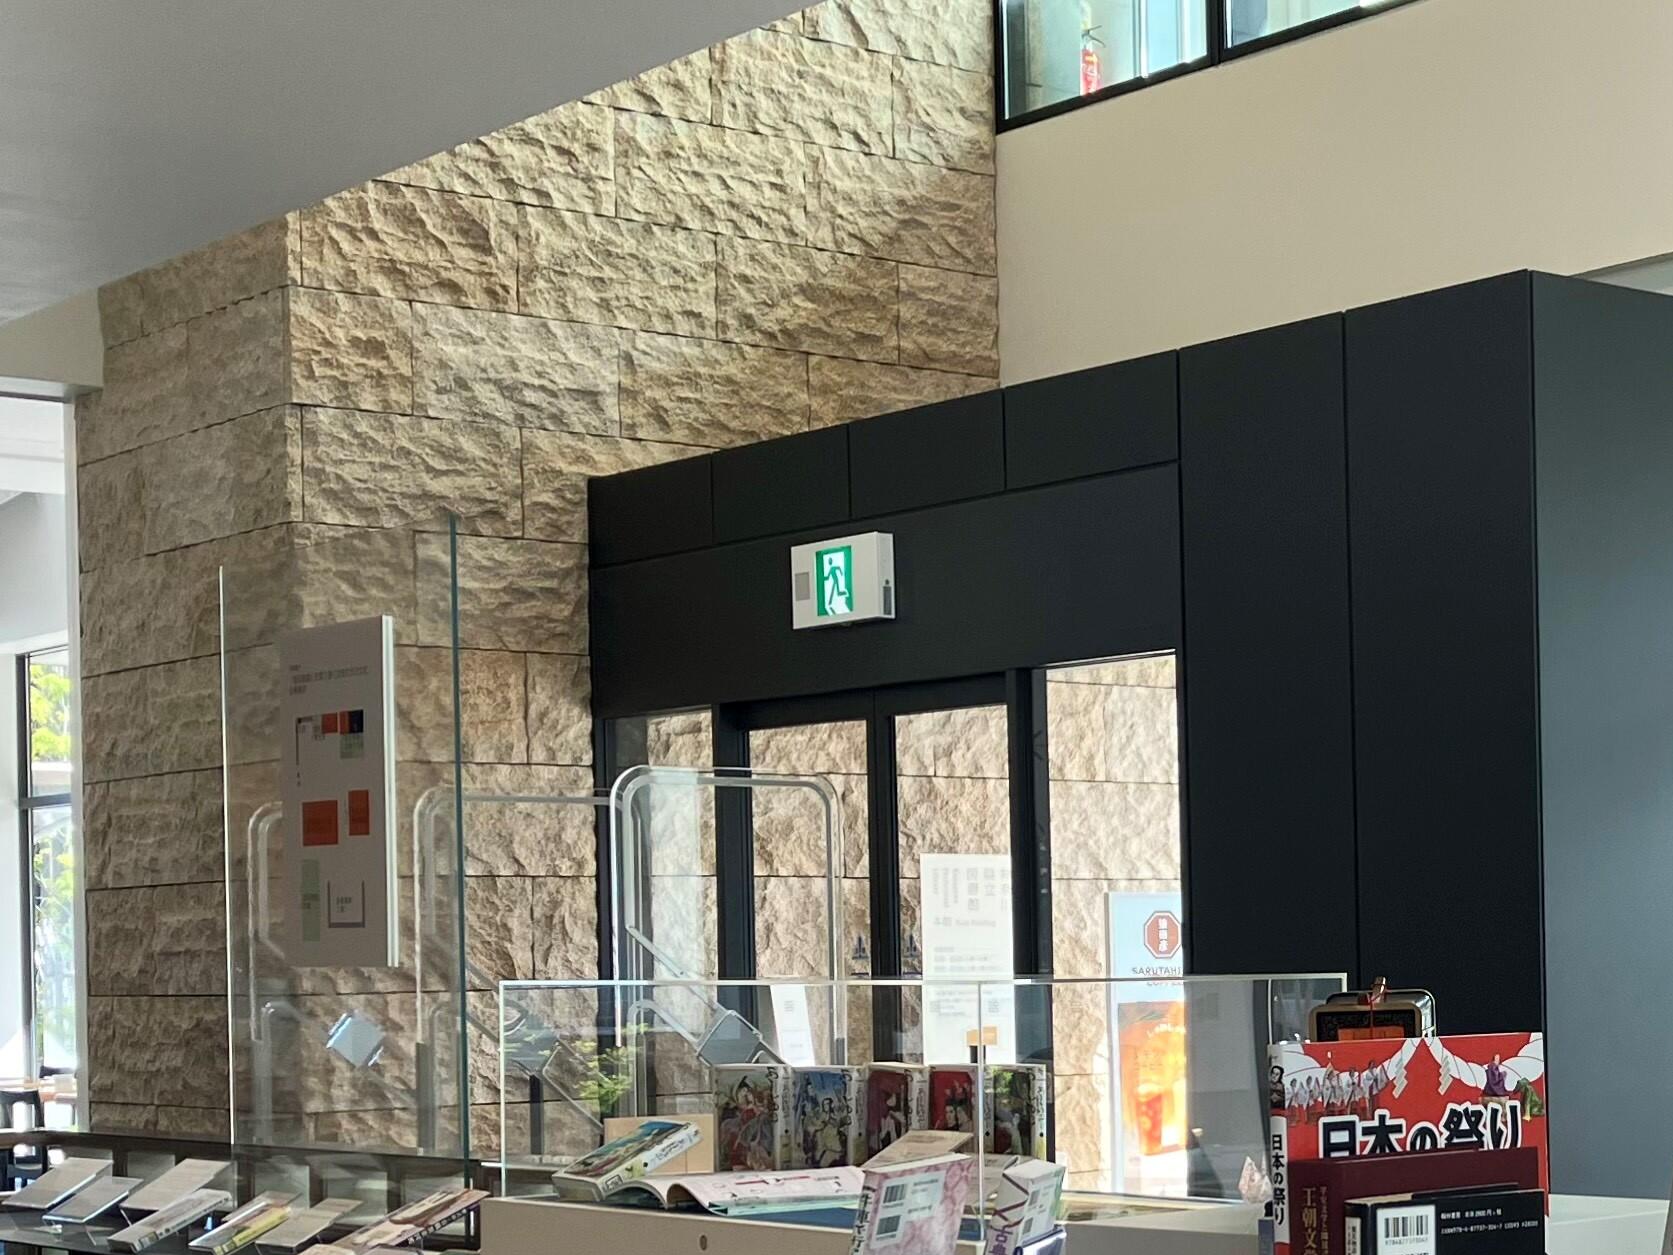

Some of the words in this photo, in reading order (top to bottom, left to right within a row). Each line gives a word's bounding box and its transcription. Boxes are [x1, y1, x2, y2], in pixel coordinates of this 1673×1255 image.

[1318, 1100, 1523, 1159] 日本の祭り
[1271, 1134, 1288, 1225] 日本の祭り
